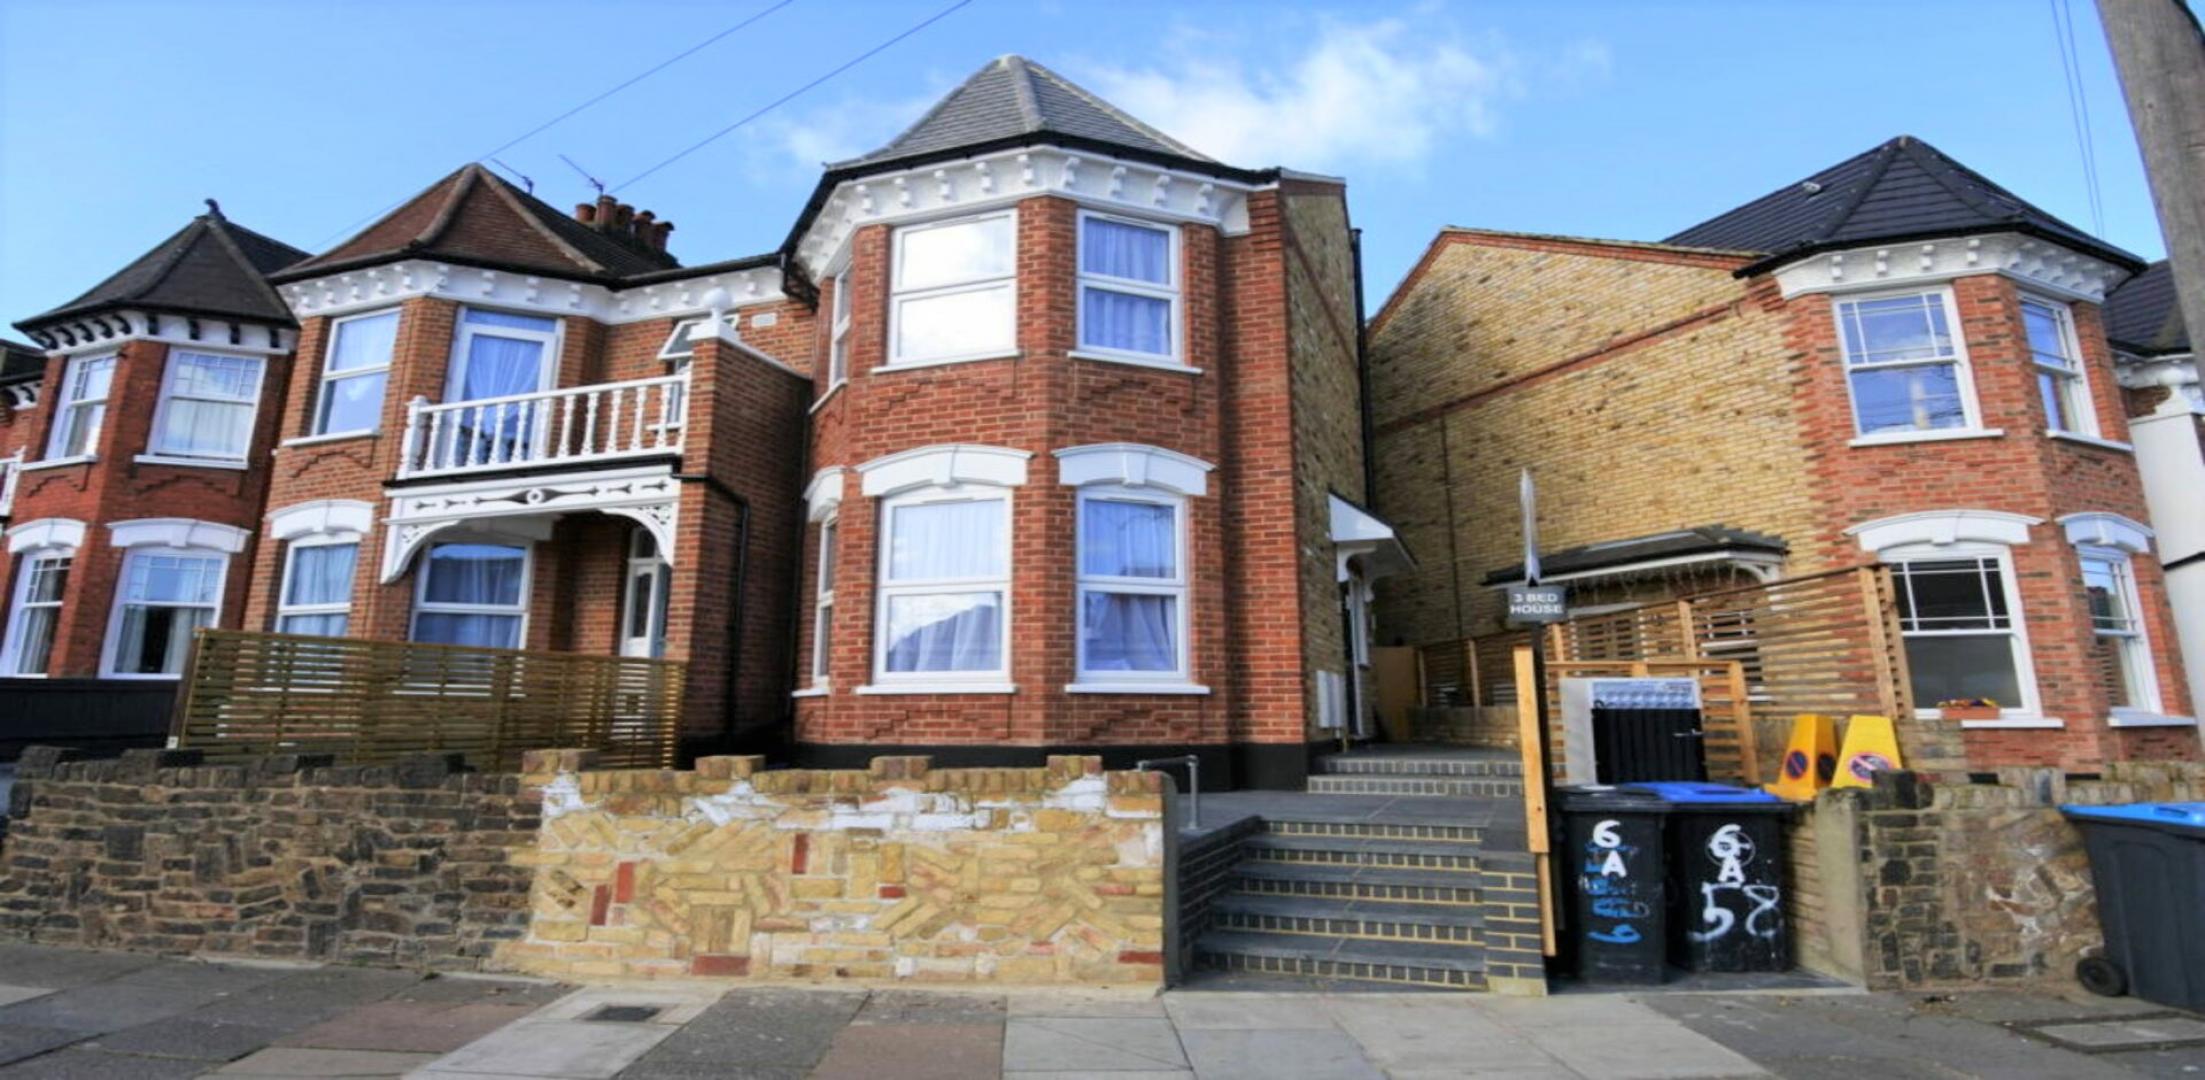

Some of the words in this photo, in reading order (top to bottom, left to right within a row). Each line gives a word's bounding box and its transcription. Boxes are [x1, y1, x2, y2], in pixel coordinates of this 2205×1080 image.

[1510, 604, 1564, 614] HOUSE
[1512, 593, 1523, 603] 3
[1526, 593, 1559, 603] BED
[1593, 819, 1621, 848] 6
[1601, 849, 1627, 878] A
[1718, 855, 1746, 882] A
